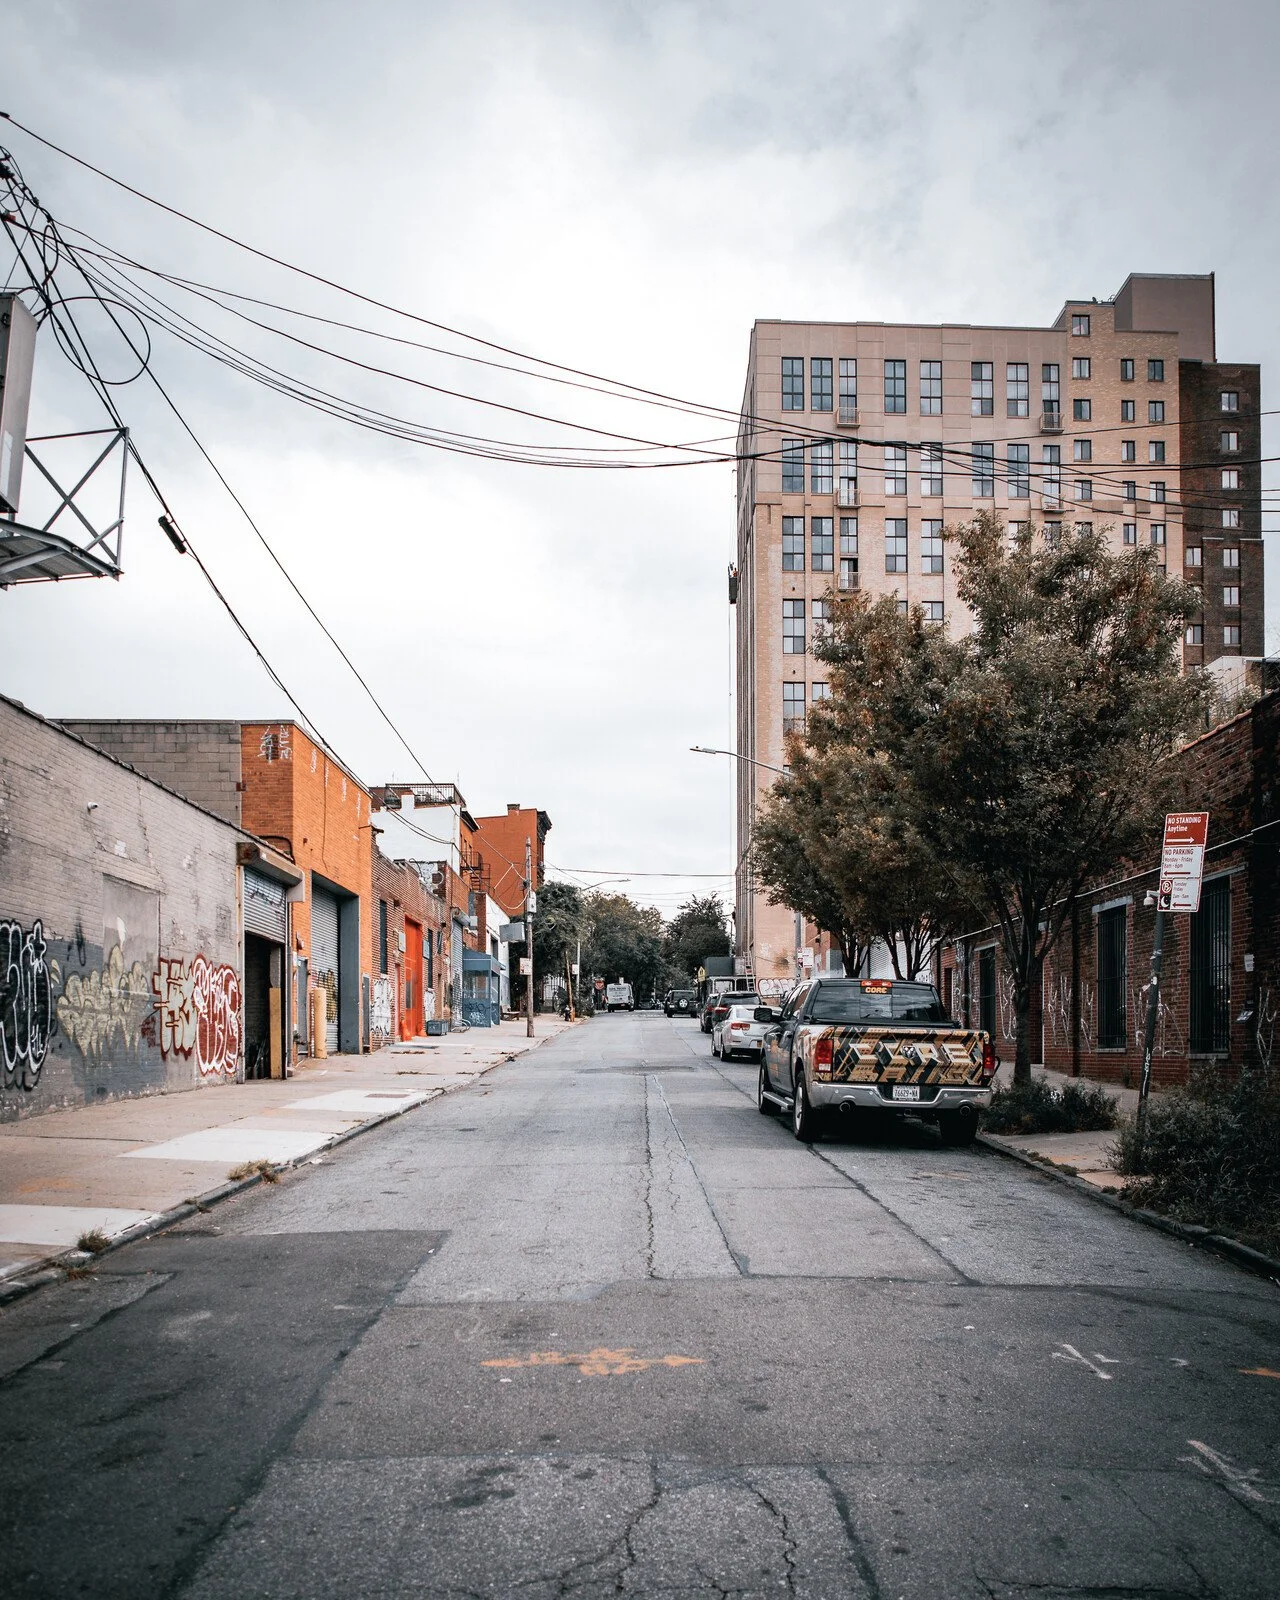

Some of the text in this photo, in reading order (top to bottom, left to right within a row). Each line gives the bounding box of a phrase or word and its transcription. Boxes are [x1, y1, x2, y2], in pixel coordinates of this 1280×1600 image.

[1176, 816, 1202, 824] STANDING
[1167, 825, 1188, 834] Anytime
[865, 986, 888, 994] CORE
